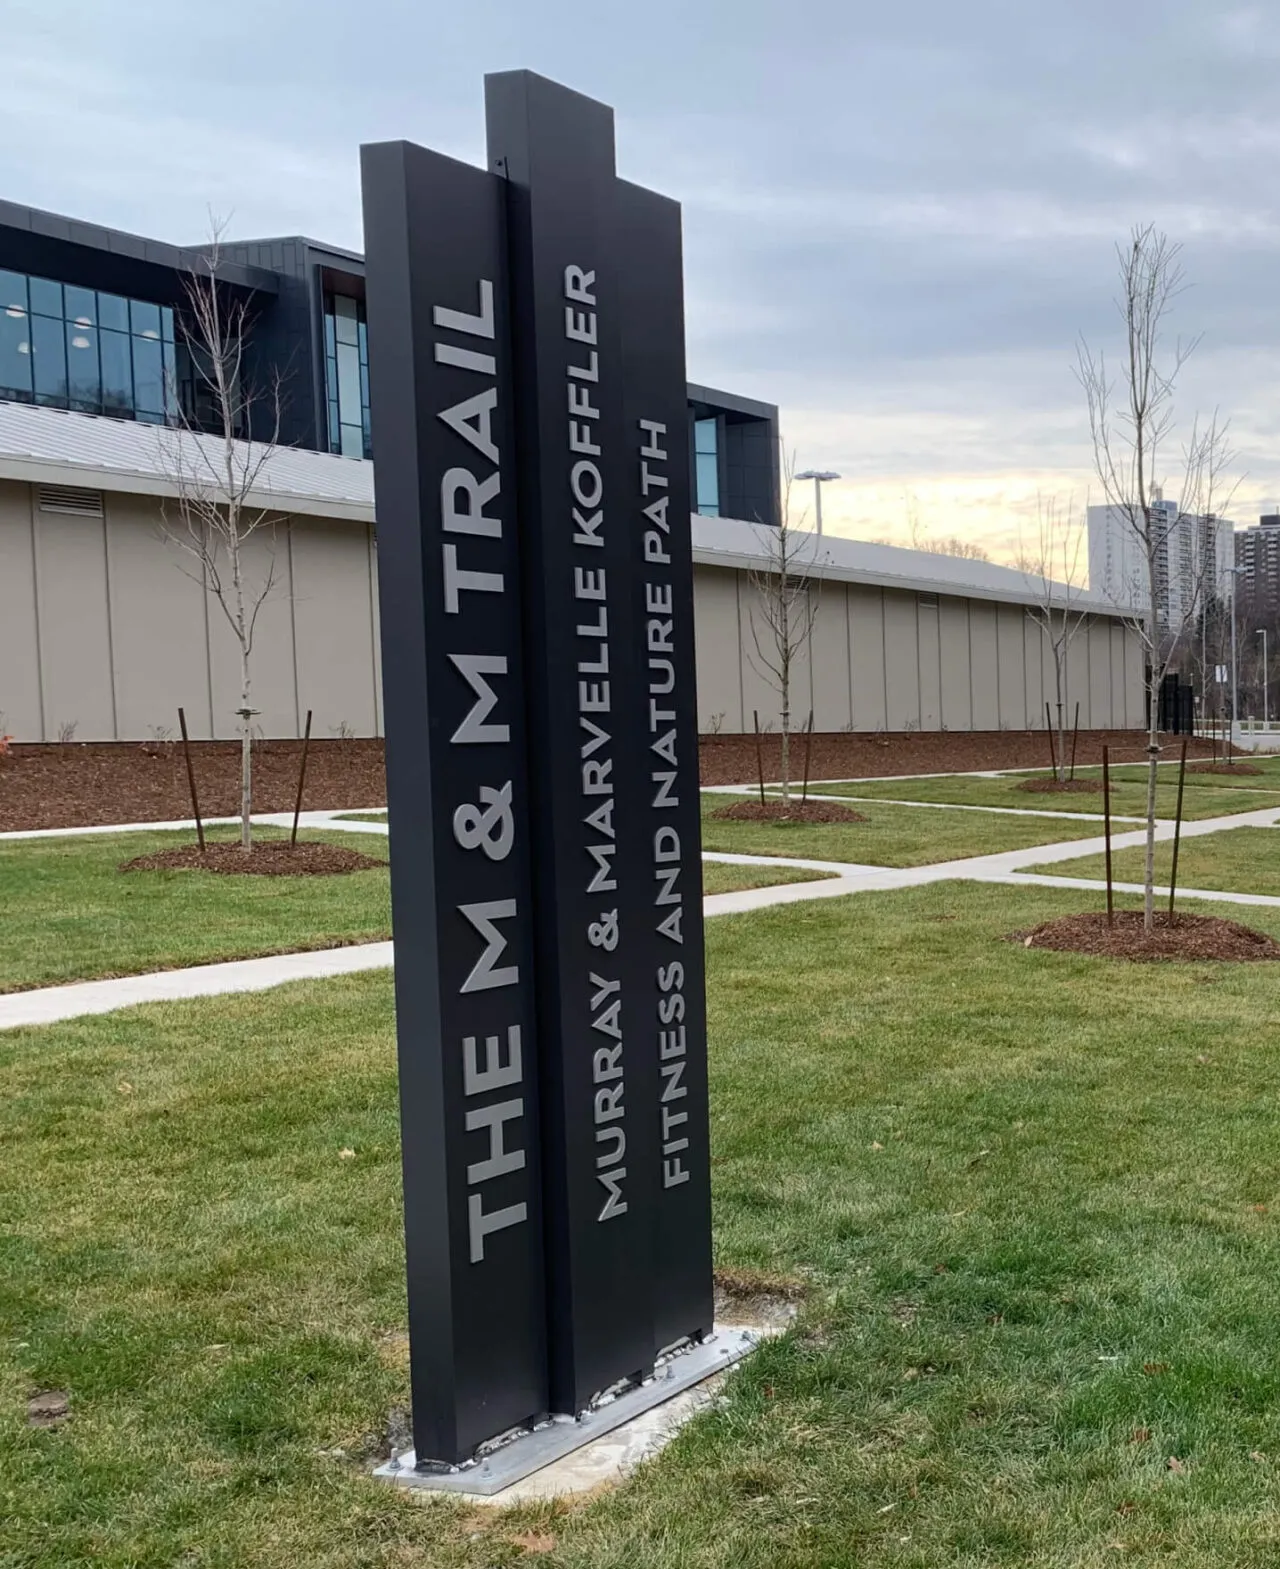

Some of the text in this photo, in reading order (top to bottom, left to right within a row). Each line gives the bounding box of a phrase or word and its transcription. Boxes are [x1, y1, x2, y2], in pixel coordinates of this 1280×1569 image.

[432, 279, 528, 1265] THE M & M TRAIL
[563, 263, 629, 1223] MURRAY & MARVELLE KOFFLER
[638, 419, 691, 1190] FITNESS AND NATURE PATH
